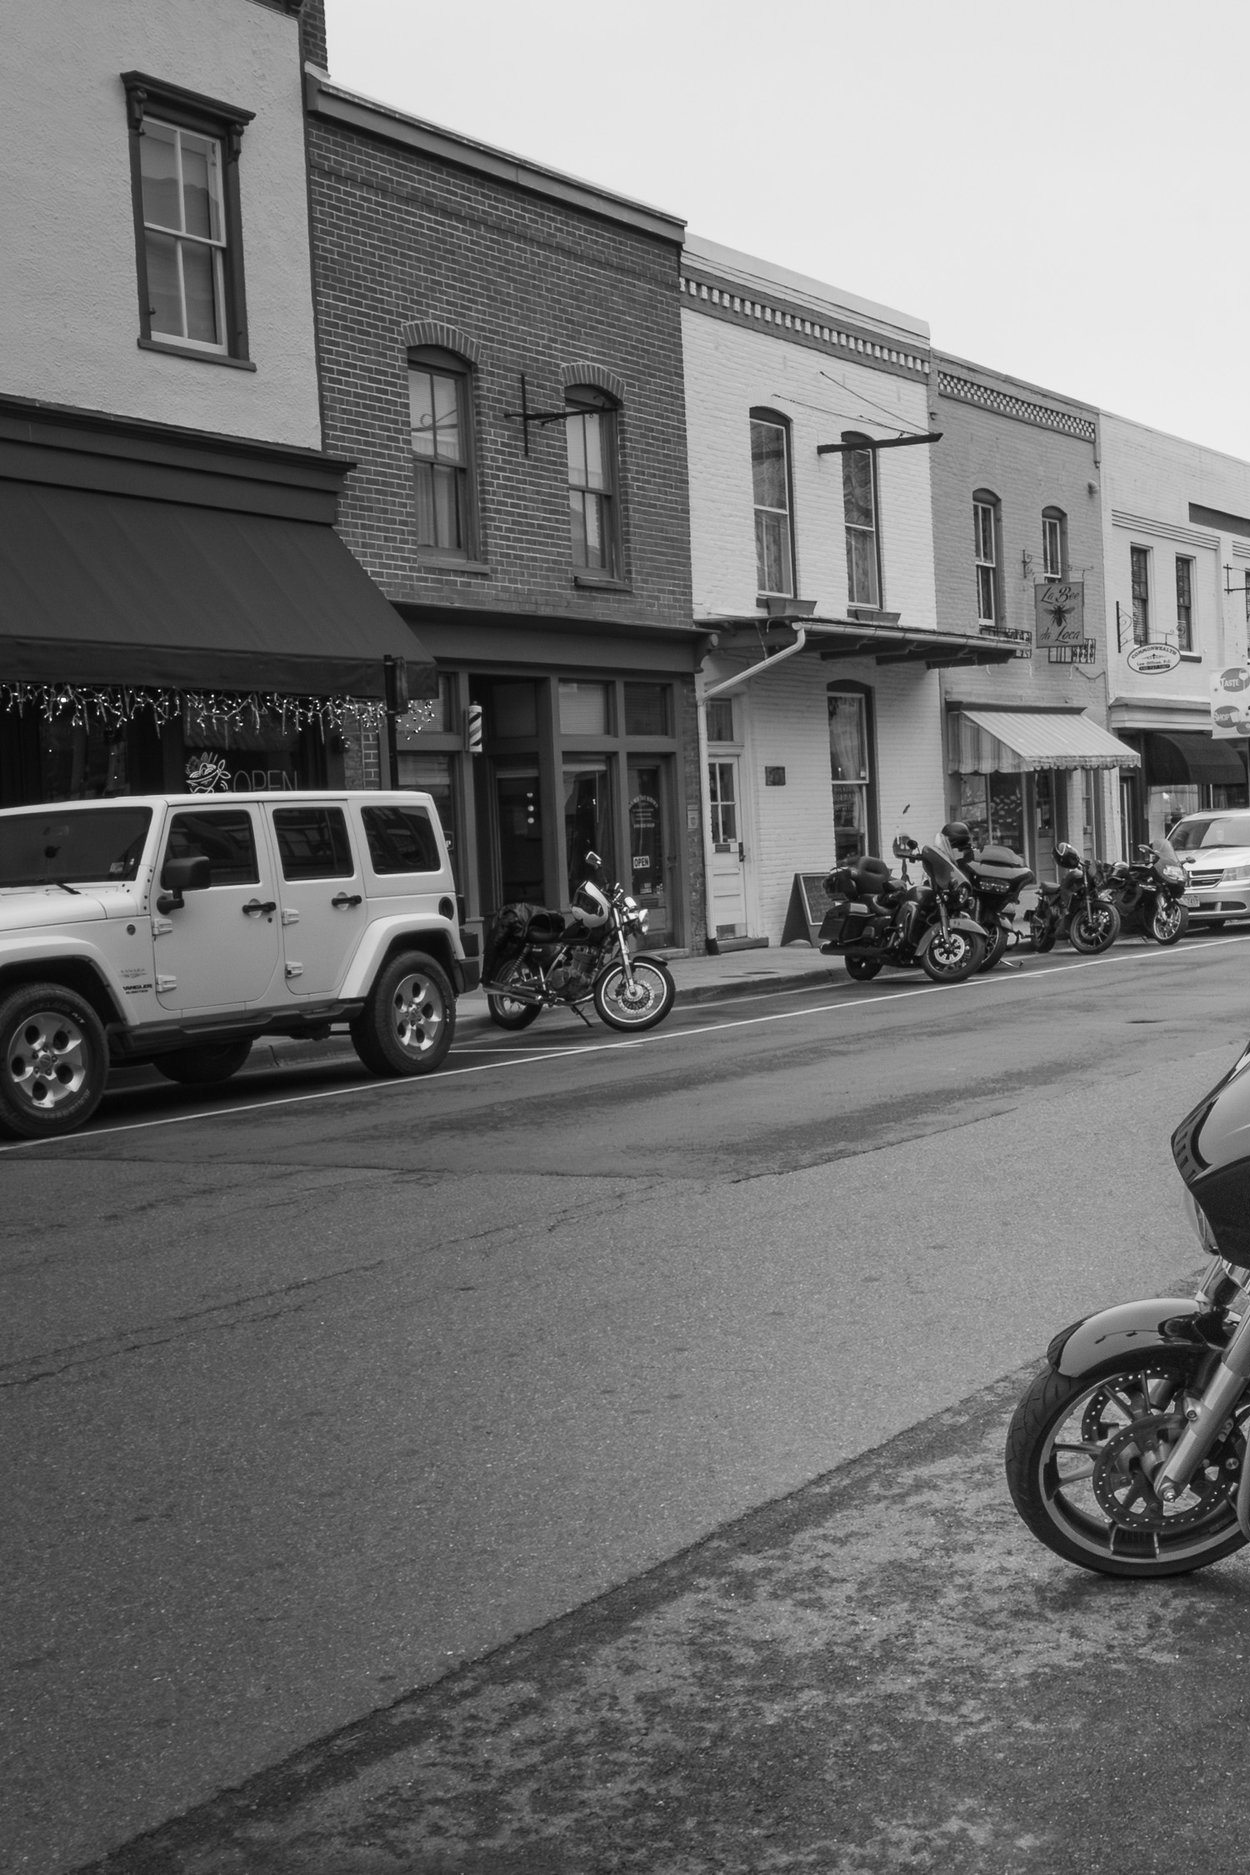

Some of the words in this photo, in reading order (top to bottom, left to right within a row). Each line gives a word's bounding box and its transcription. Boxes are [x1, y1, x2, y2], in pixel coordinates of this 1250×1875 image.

[1041, 586, 1055, 605] La
[1055, 625, 1081, 644] Loca
[233, 770, 298, 792] OPEN
